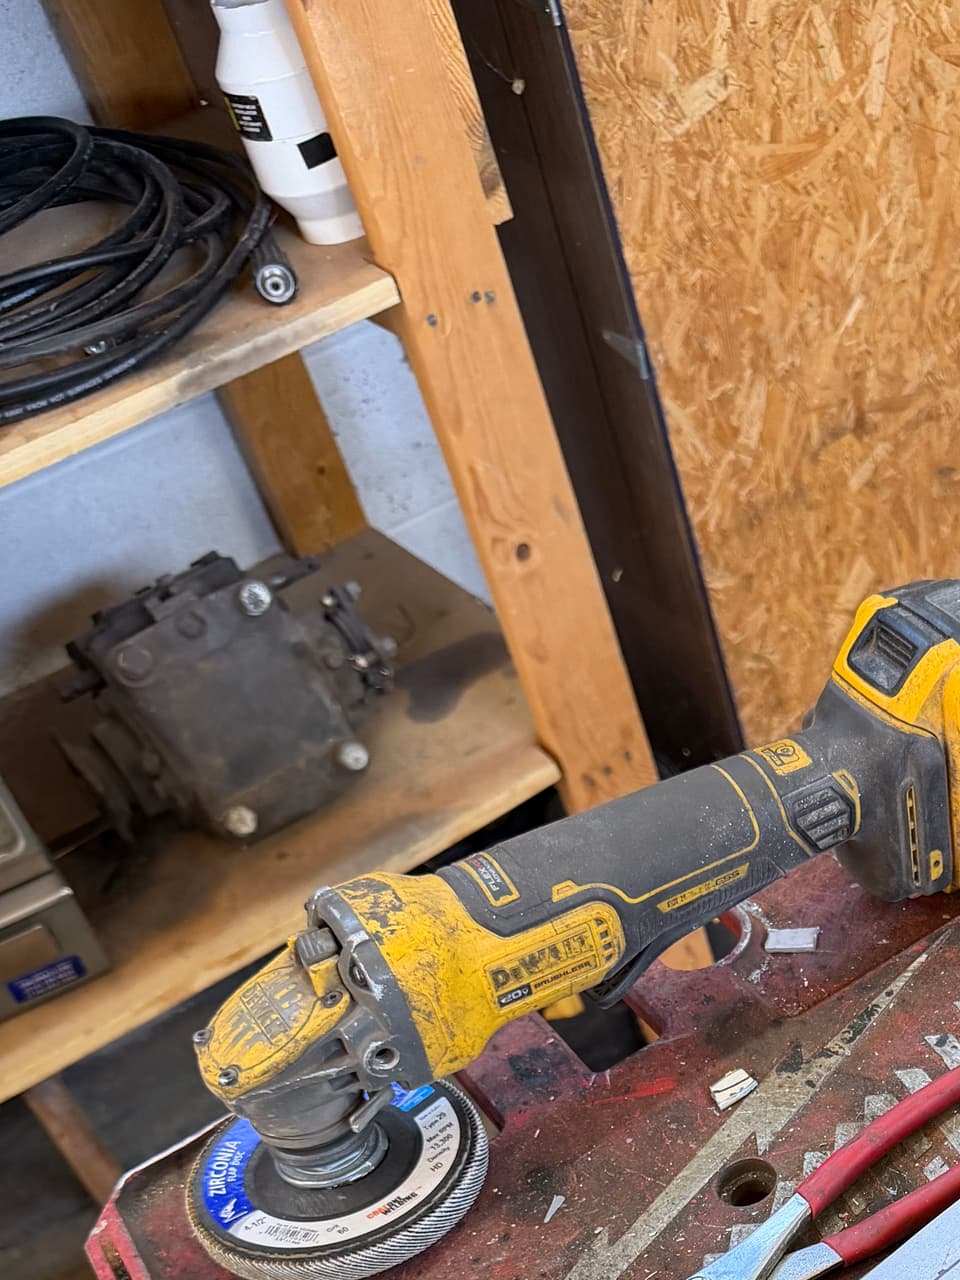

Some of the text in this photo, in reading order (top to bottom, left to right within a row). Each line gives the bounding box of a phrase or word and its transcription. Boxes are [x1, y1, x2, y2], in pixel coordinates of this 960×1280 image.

[208, 1140, 241, 1197] ZIRCONIA
[227, 1151, 246, 1182] FLAP DISC
[429, 1162, 444, 1173] HD
